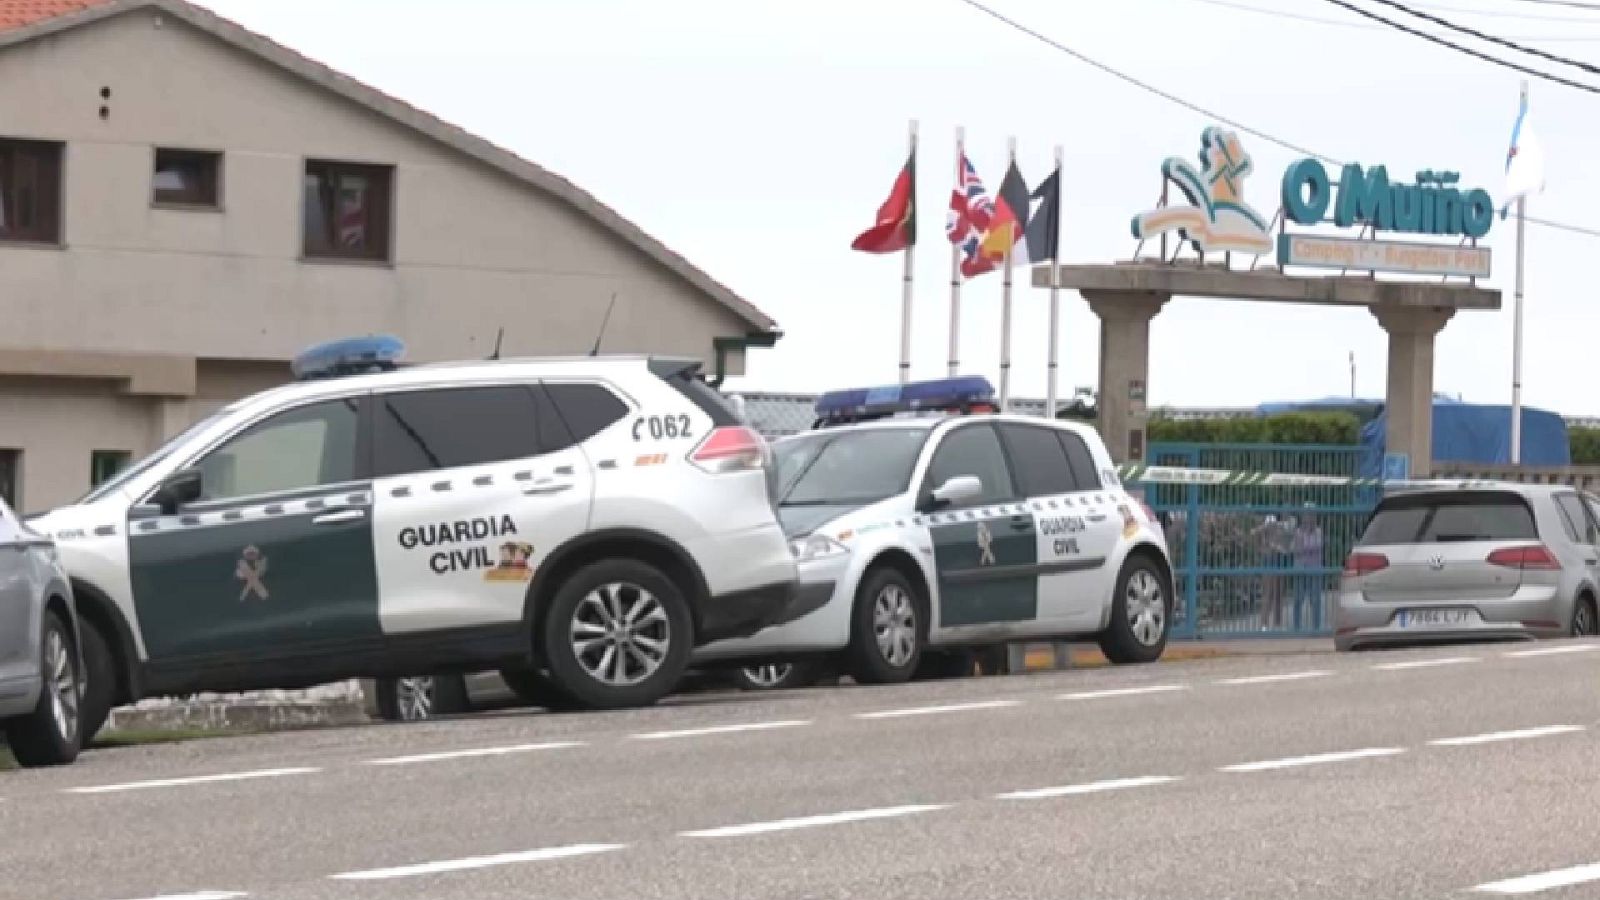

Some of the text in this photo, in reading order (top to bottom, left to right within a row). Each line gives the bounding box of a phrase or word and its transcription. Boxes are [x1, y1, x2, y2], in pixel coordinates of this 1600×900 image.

[1283, 158, 1330, 226] O
[1294, 239, 1354, 264] Camping
[1454, 250, 1485, 270] Park
[648, 413, 692, 440] 062
[399, 514, 517, 549] GUARDIA
[1039, 516, 1086, 536] GUARDIA
[429, 546, 494, 574] CIVIL
[1053, 538, 1080, 555] CIVIL
